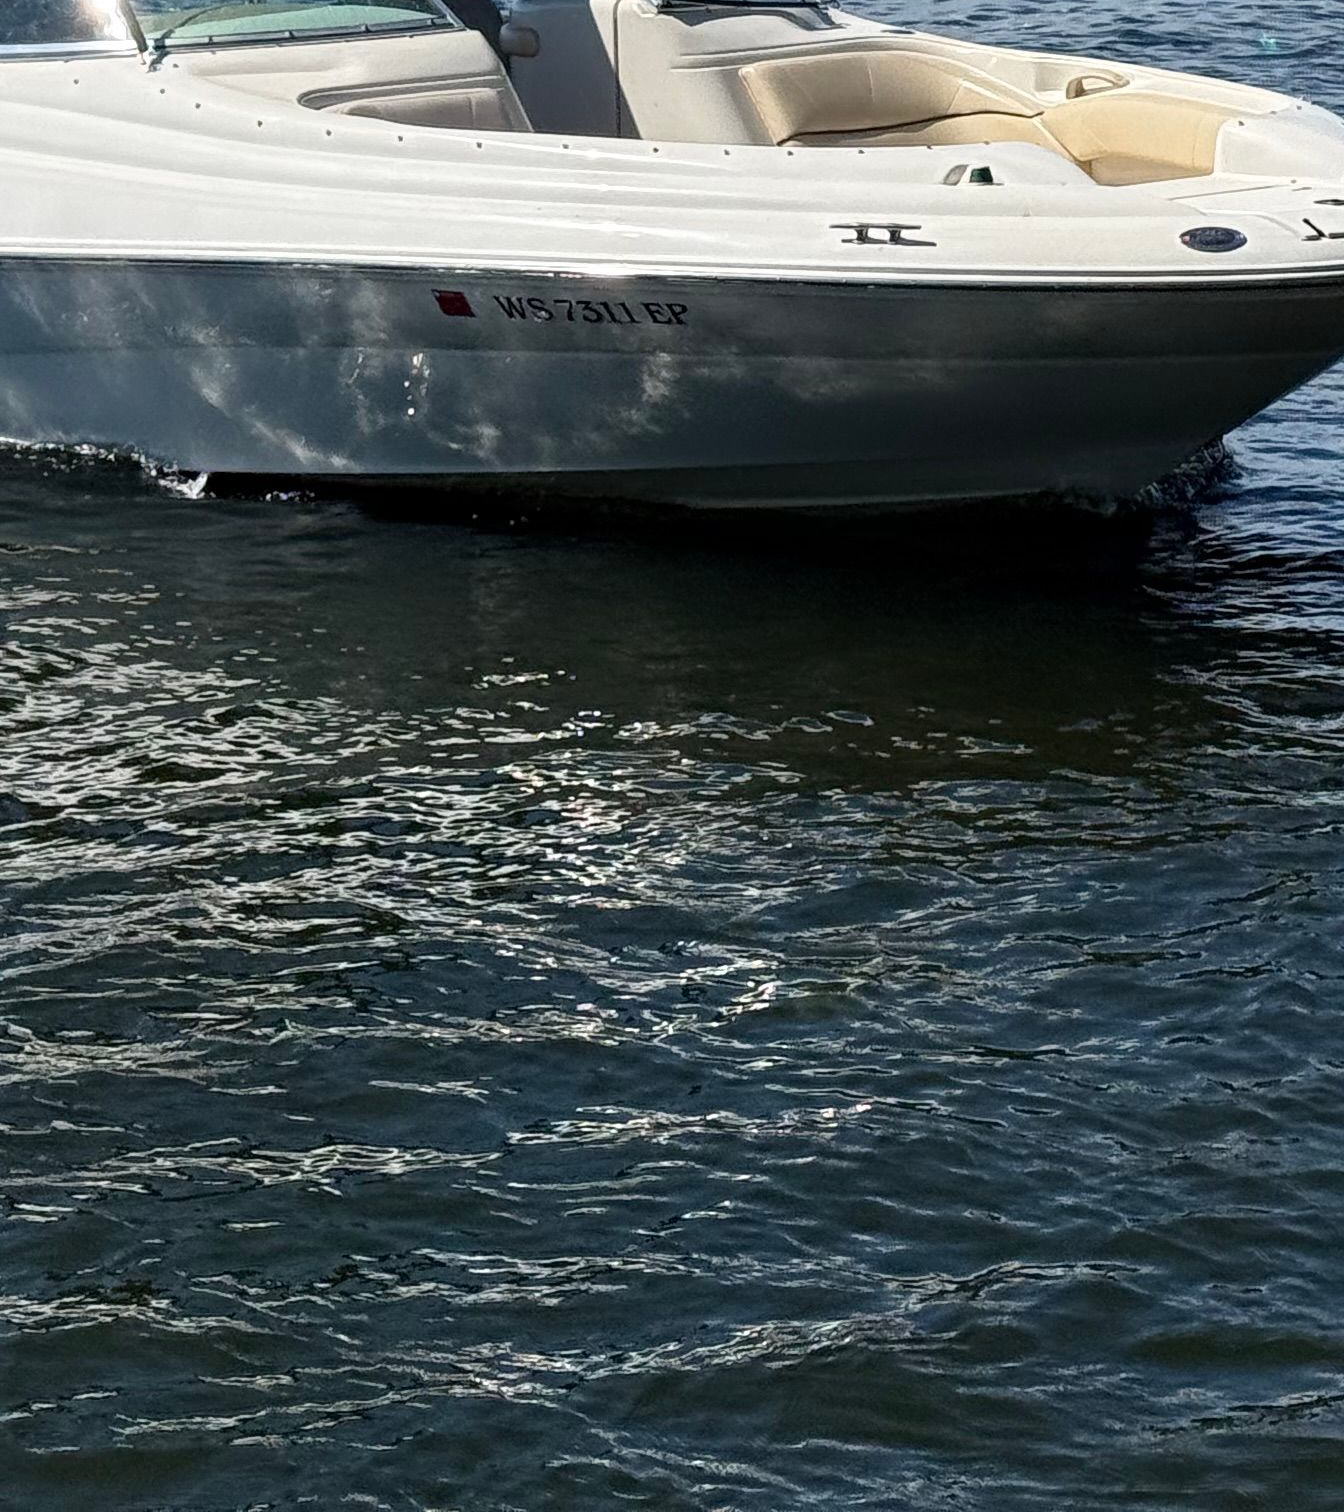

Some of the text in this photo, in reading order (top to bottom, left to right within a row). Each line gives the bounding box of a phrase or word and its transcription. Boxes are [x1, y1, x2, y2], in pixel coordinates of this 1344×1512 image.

[493, 295, 689, 325] WS 7311 EP
